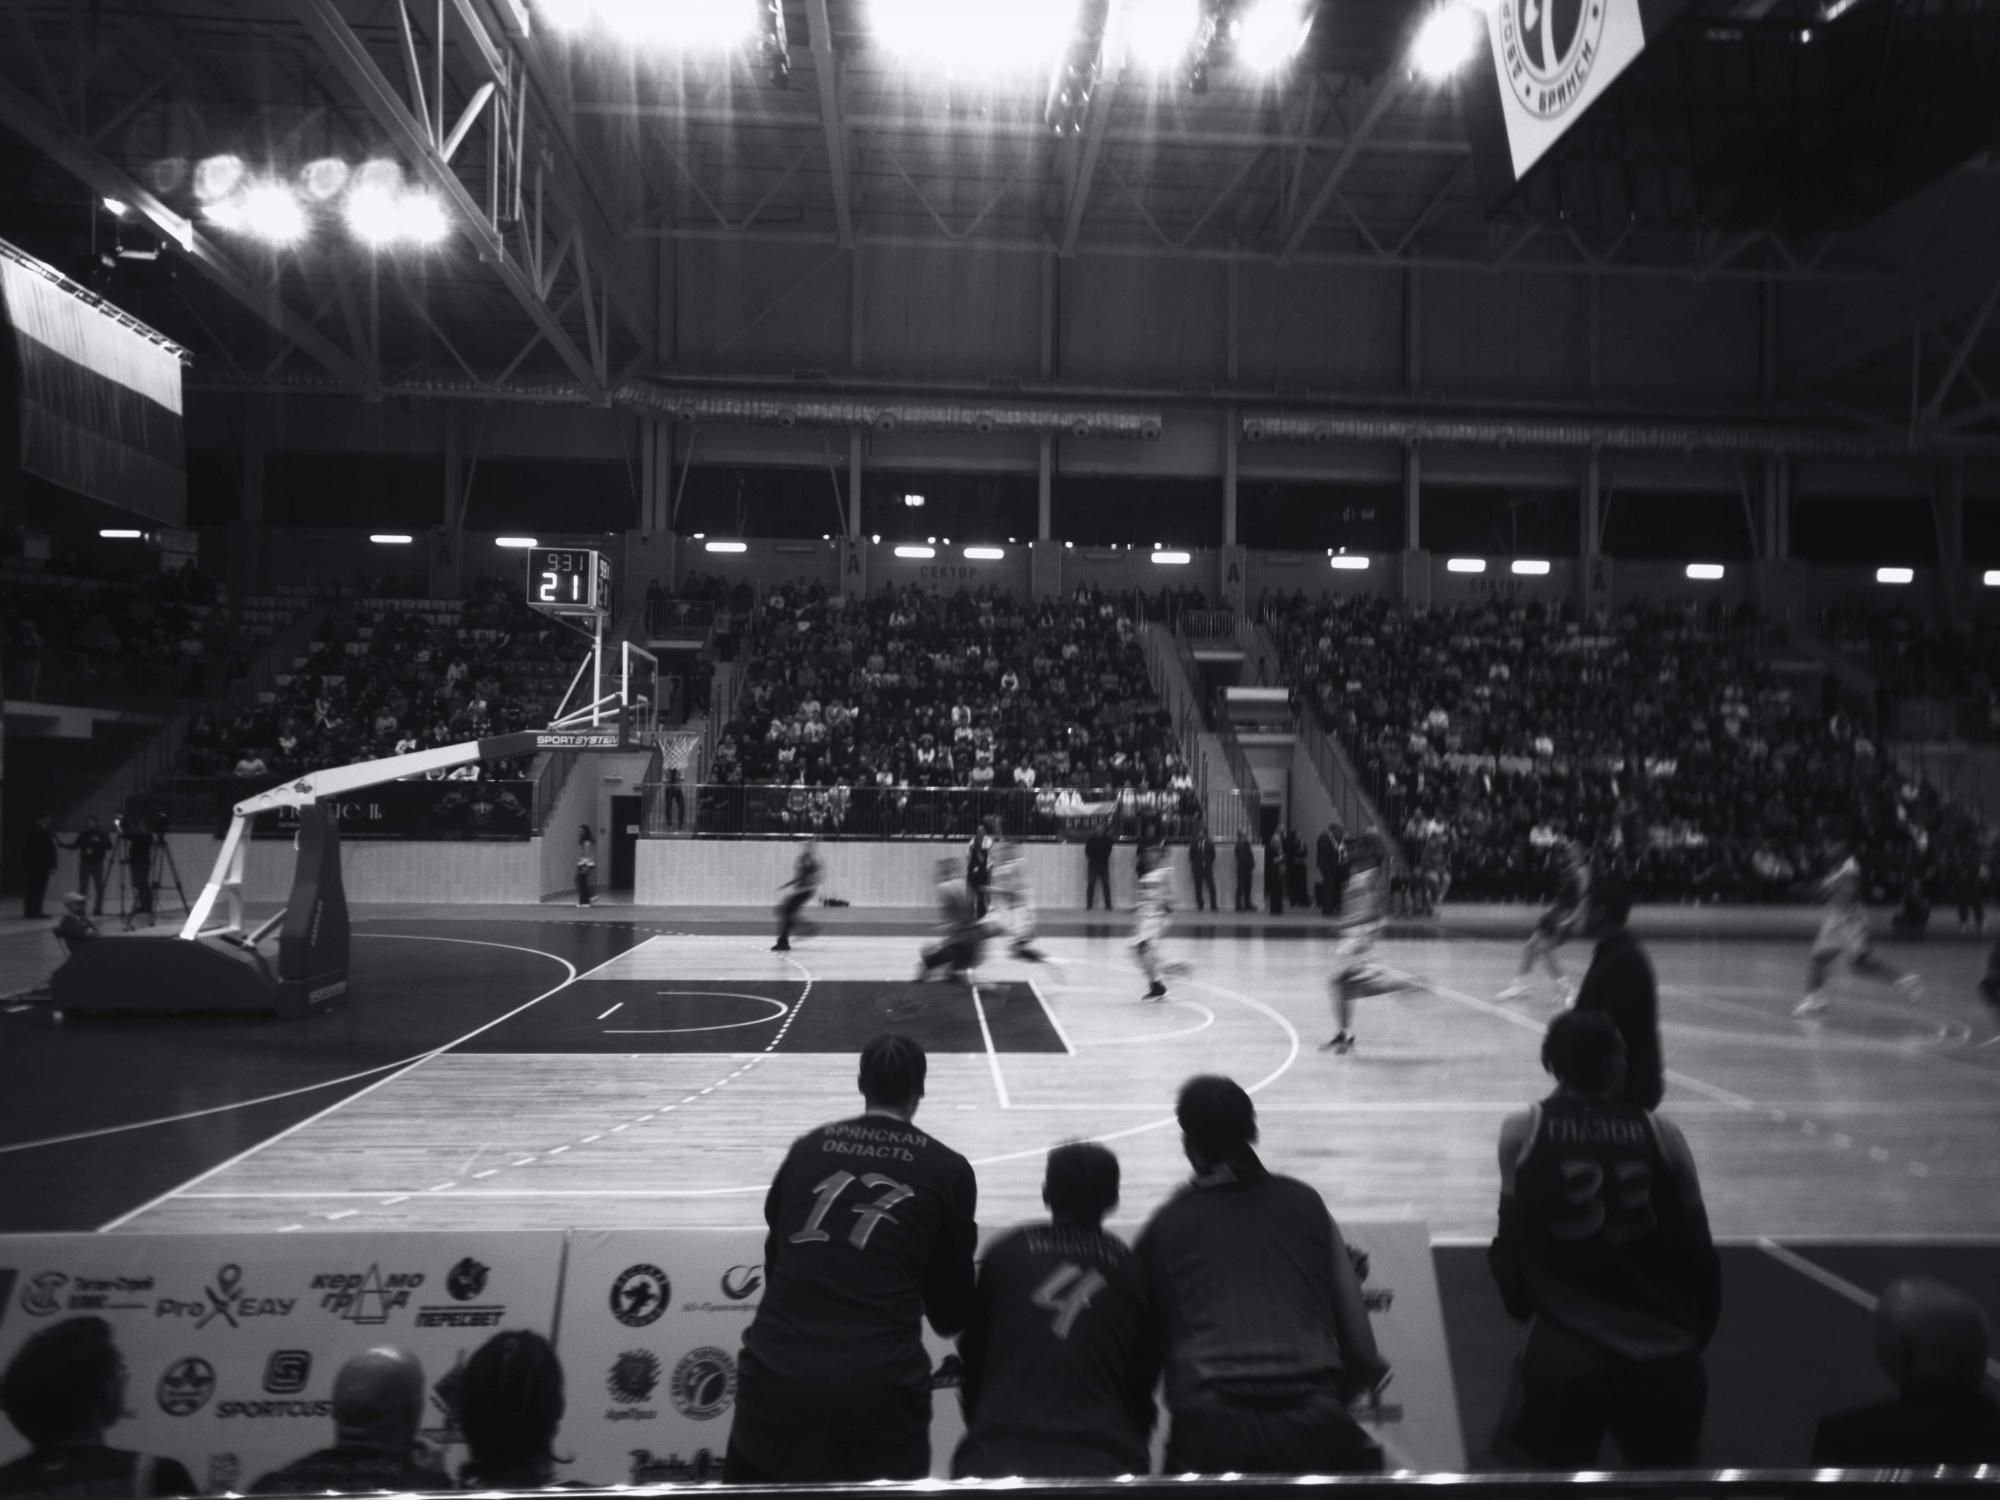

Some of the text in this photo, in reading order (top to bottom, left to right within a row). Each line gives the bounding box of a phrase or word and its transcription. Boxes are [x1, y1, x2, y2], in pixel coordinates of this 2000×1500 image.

[540, 572, 578, 602] 21
[824, 1122, 929, 1148] БРЯНСКАЯ
[822, 1138, 915, 1162] ОБЛАСТЬ
[789, 1169, 916, 1251] 17
[1030, 1262, 1108, 1340] 4
[415, 1311, 506, 1328] ПЕРЕСВЕТ
[214, 1400, 335, 1418] SPORTCUS
